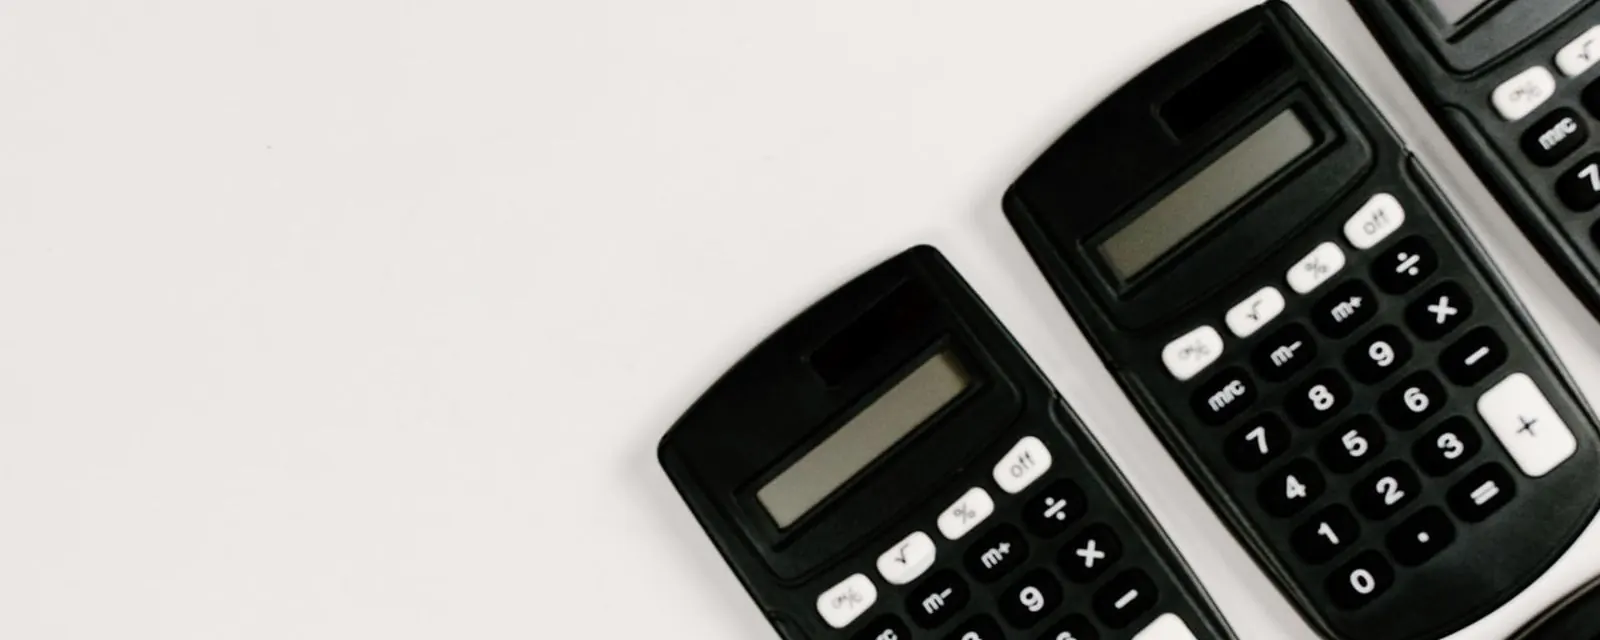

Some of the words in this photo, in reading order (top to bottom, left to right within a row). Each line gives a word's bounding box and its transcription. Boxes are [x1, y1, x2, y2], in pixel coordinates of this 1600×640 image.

[1577, 163, 1600, 191] 7
[1362, 208, 1390, 237] off
[1368, 341, 1395, 367] 9
[1208, 379, 1245, 411] mrc
[1308, 384, 1335, 411] 8
[1403, 386, 1430, 413] 6
[1245, 426, 1269, 454] 7
[1341, 429, 1369, 457] 5
[1436, 432, 1464, 459] 3
[1009, 450, 1036, 479] off
[1285, 475, 1307, 499] 4
[1375, 476, 1405, 505] 2
[1317, 521, 1340, 545] 1
[1349, 568, 1376, 594] 0
[1019, 586, 1046, 612] 9
